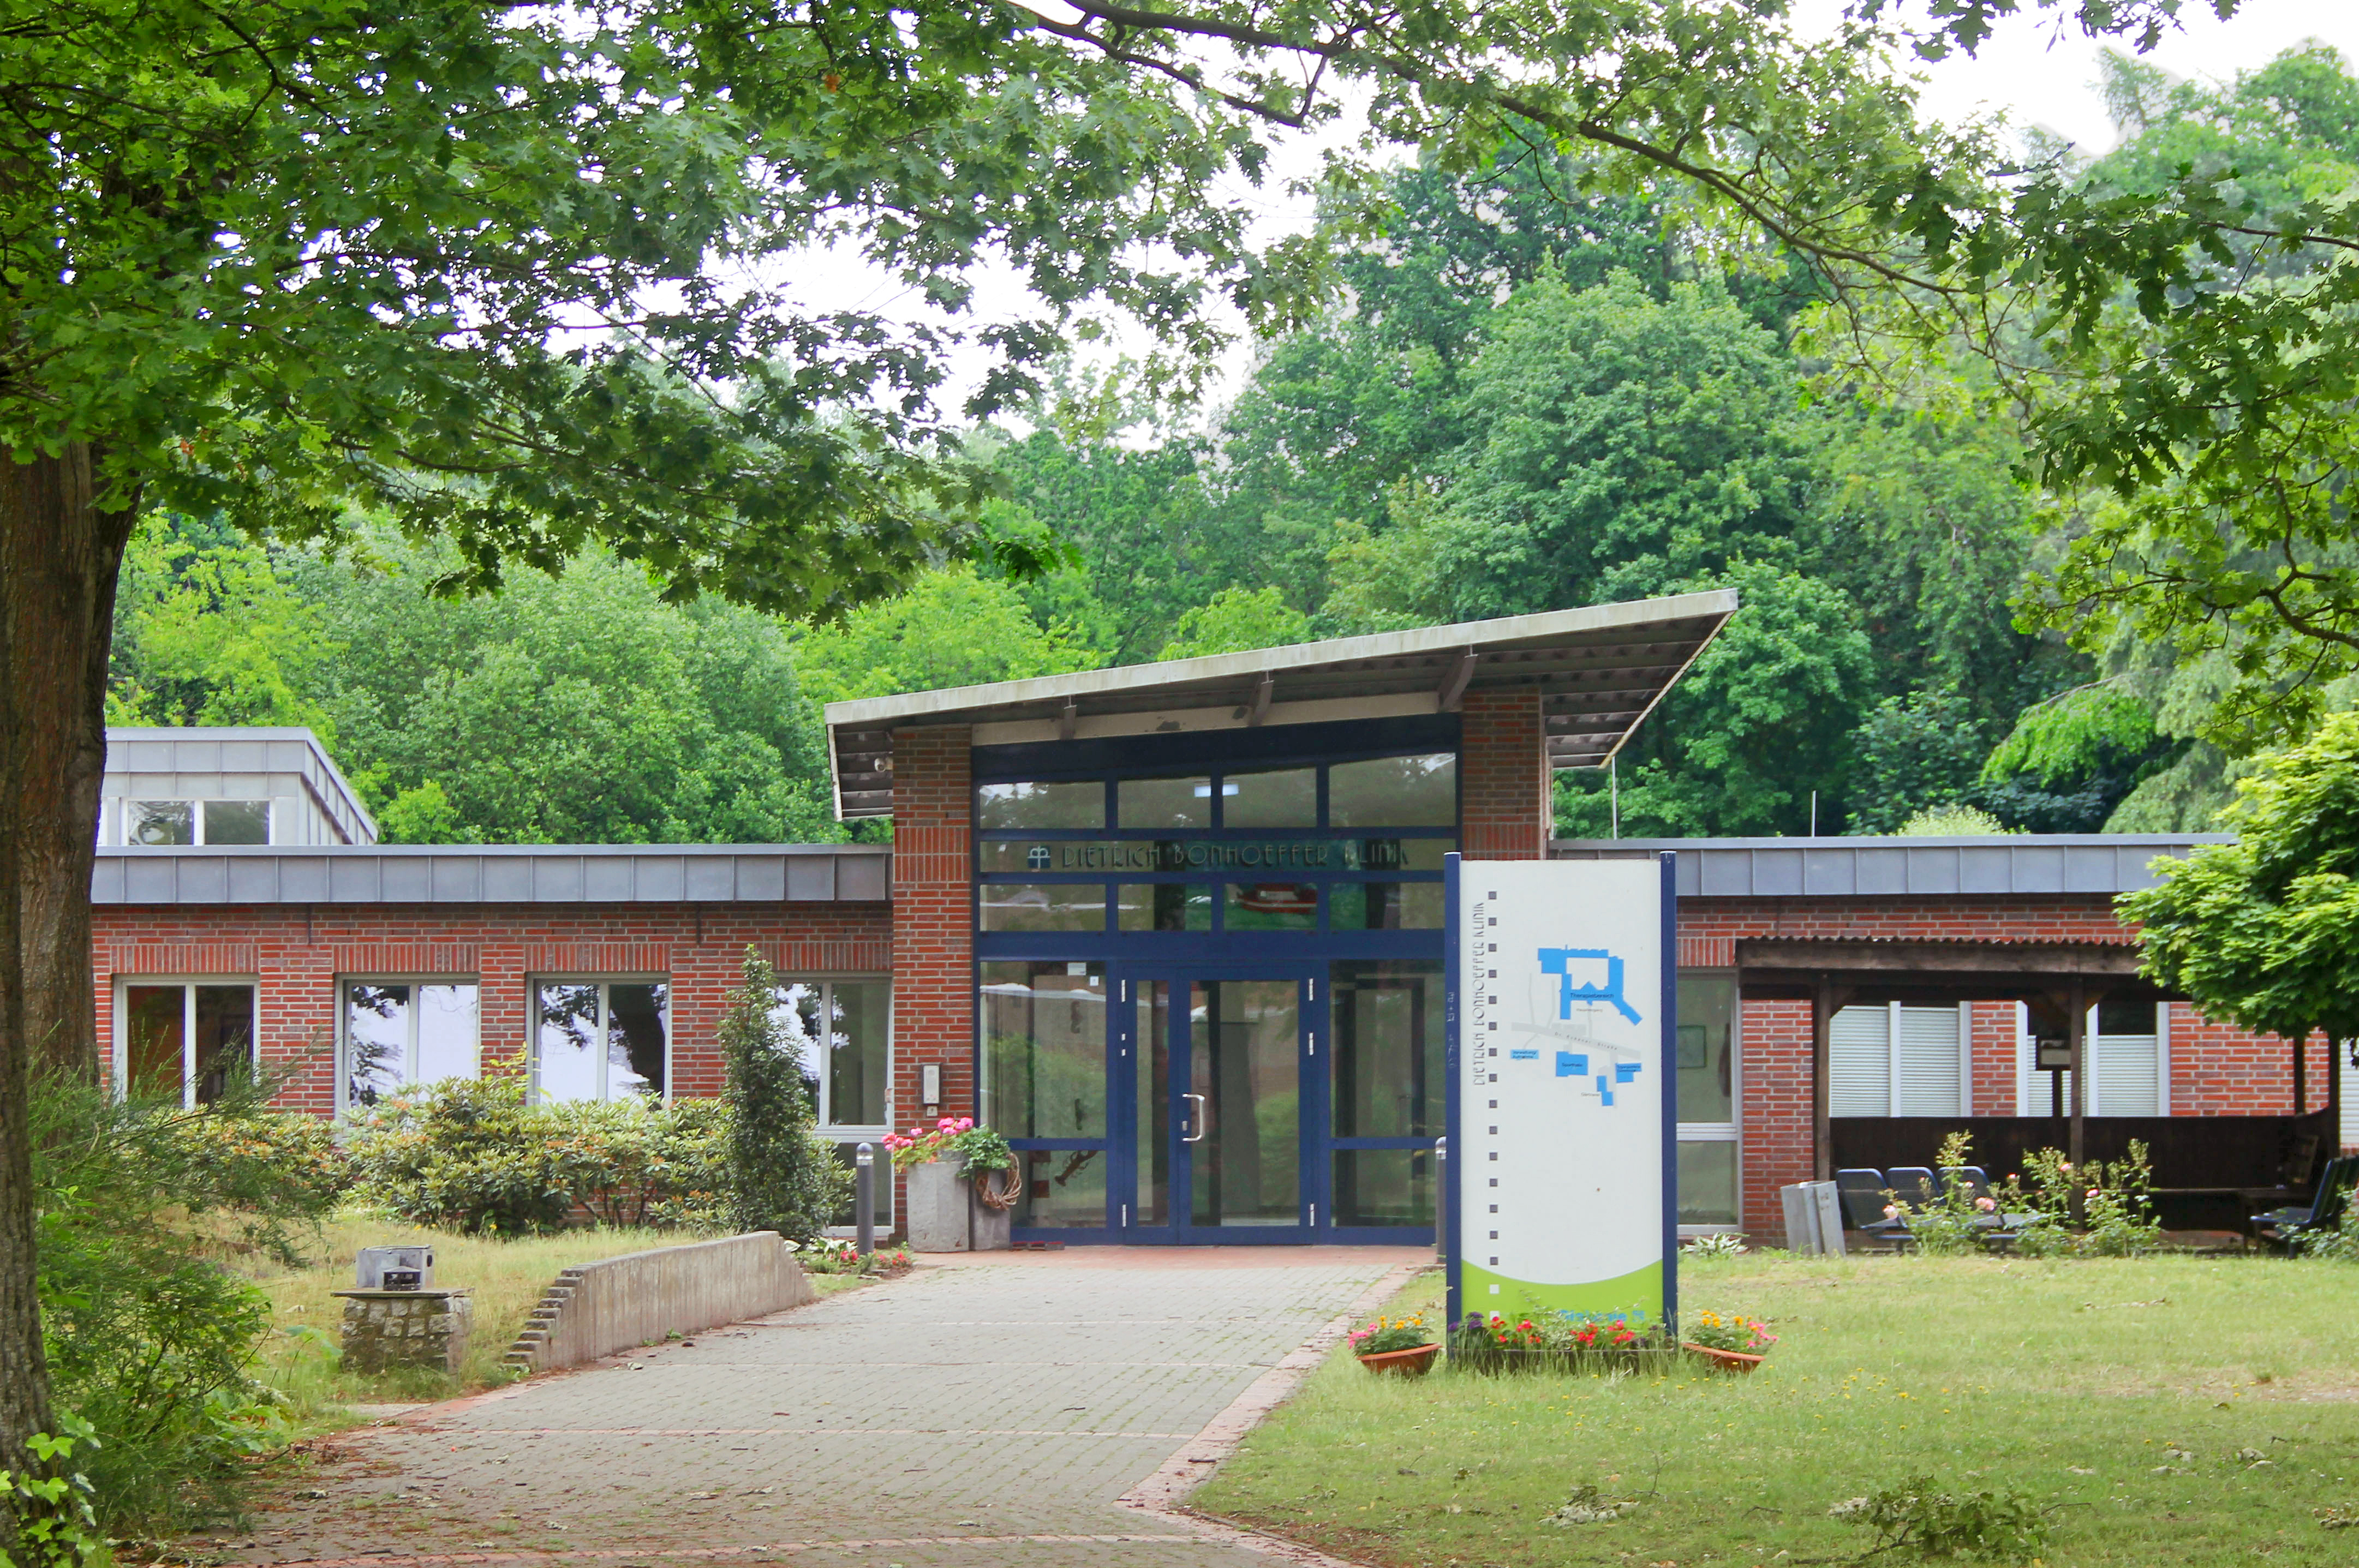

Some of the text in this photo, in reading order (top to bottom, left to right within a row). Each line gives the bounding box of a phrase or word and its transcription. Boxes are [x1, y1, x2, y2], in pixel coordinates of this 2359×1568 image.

[1063, 845, 1160, 866] DIETRICH
[1174, 844, 1328, 865] BONHOEFFER
[1473, 902, 1485, 1085] DIETRICH BONHOEFFER KLINIK
